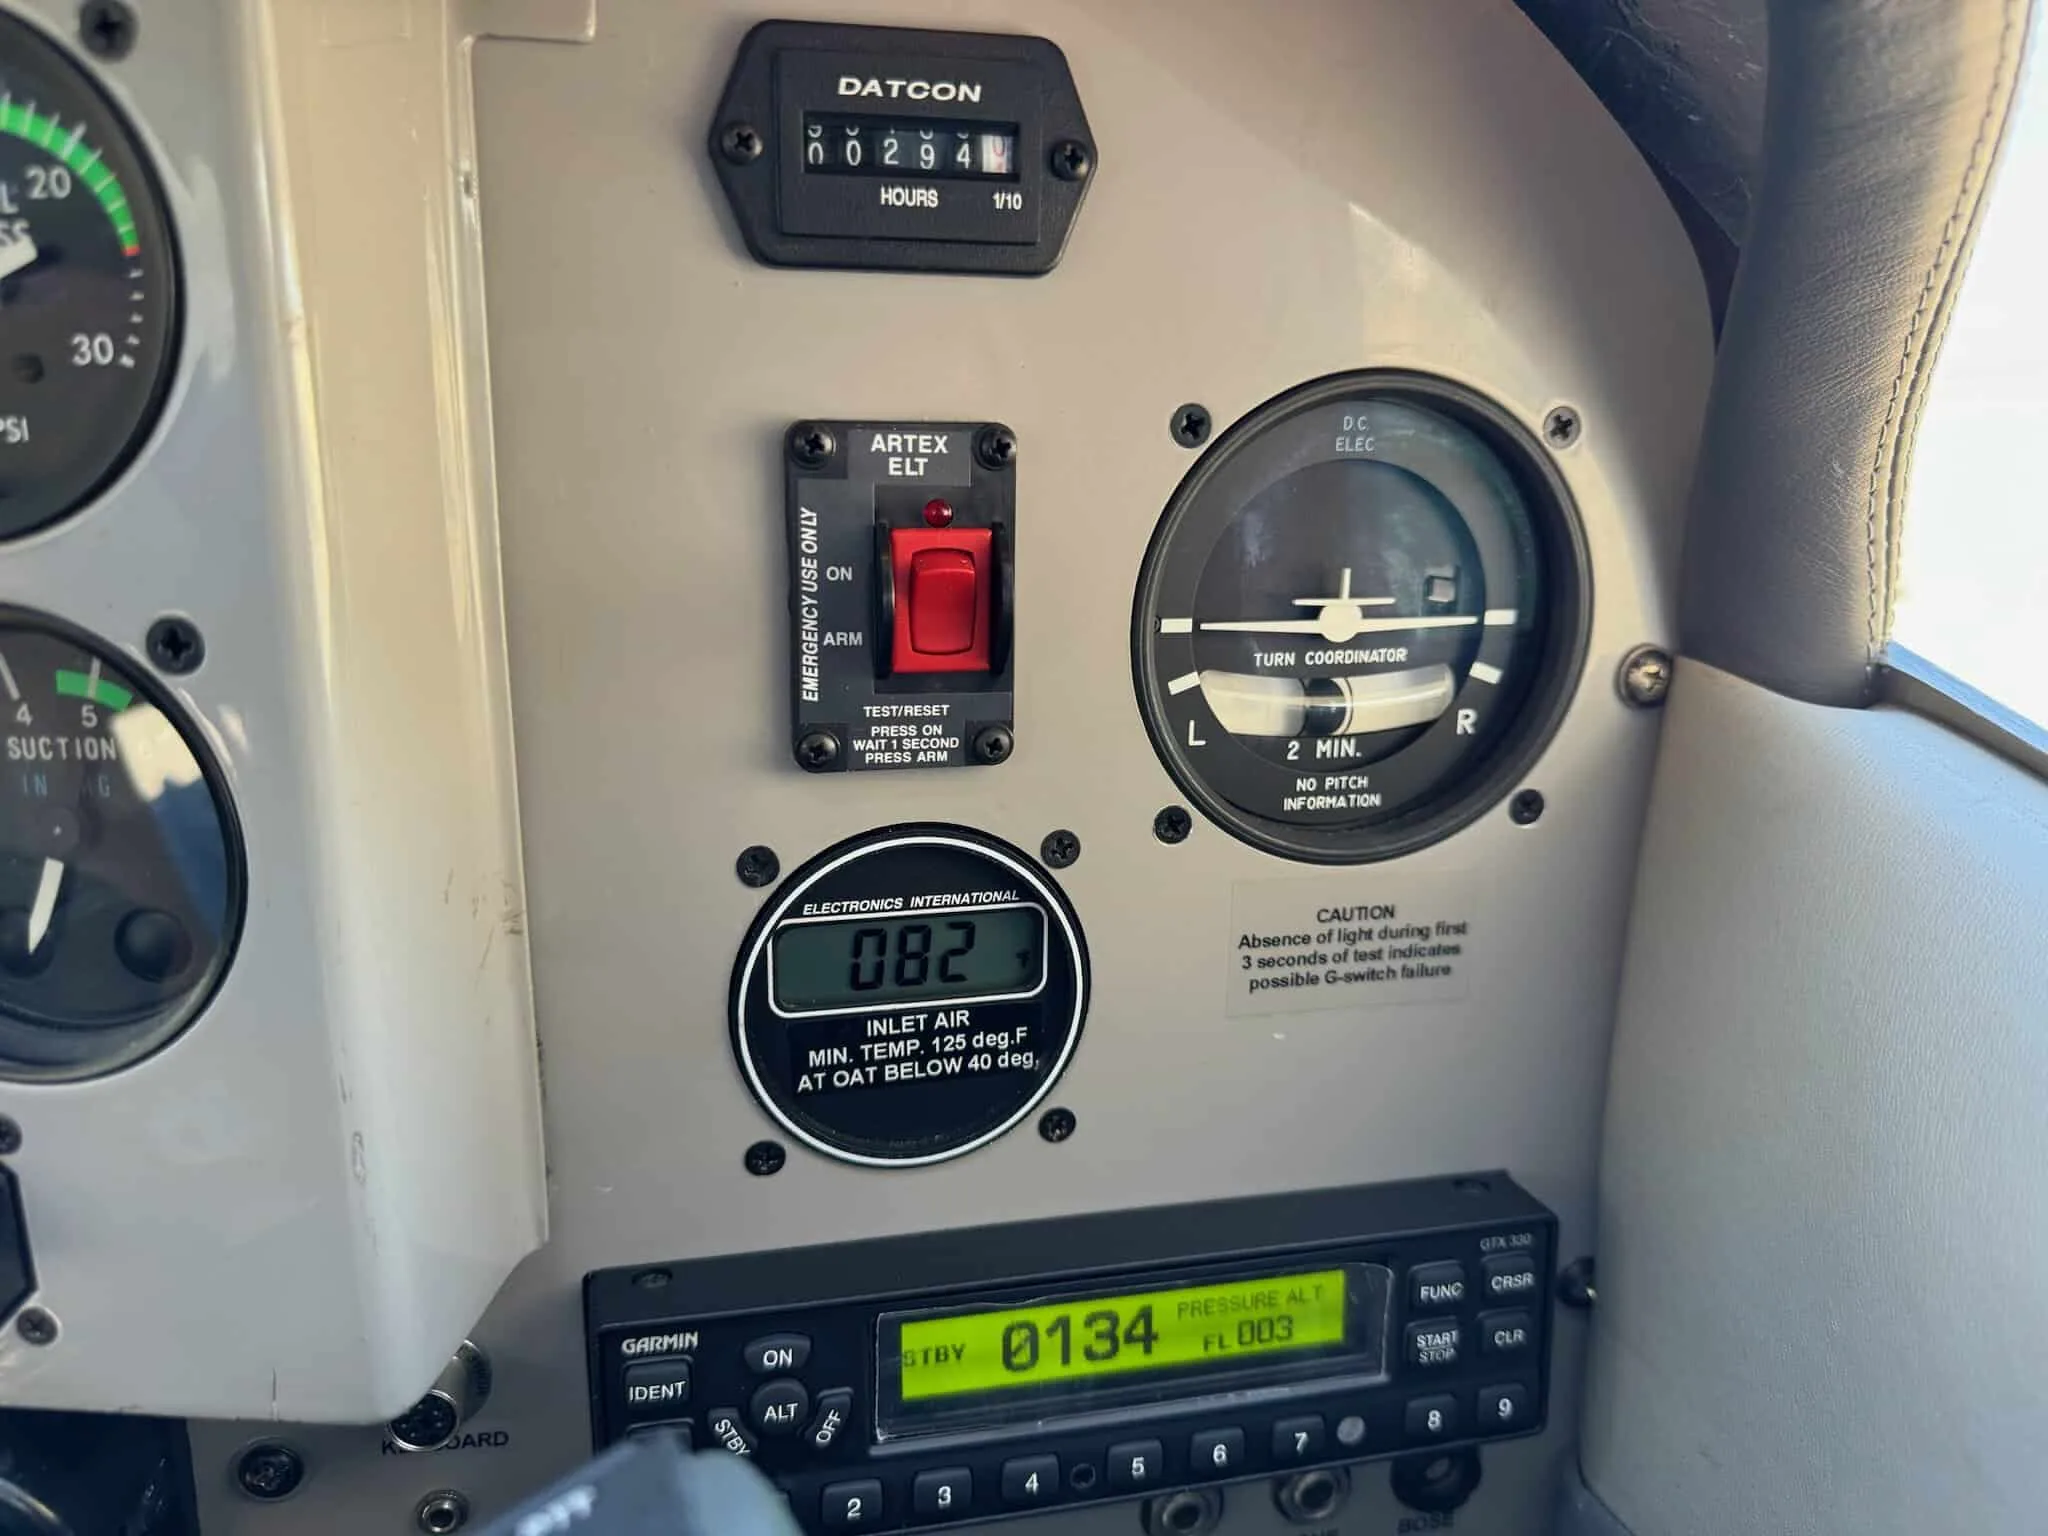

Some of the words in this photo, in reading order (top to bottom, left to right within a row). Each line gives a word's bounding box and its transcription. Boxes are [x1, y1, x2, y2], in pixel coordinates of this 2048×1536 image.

[838, 77, 982, 103] DATCON
[26, 166, 72, 200] 20
[880, 187, 939, 208] HOURS
[993, 193, 1022, 211] 1/10
[71, 334, 114, 366] 30
[871, 434, 948, 454] ARTEX
[1335, 436, 1377, 452] ELEC
[889, 457, 928, 476] ELT
[800, 506, 818, 553] ONLY
[800, 554, 818, 593] USE
[826, 566, 853, 581] ON
[801, 595, 818, 702] EMERGENCY
[823, 632, 863, 647] ARM
[1254, 651, 1296, 667] TURN
[1304, 647, 1408, 666] COORDINATOR
[16, 703, 33, 727] 4
[81, 703, 98, 728] 5
[864, 704, 950, 718] TEST/RESET
[1456, 709, 1476, 735] R
[871, 725, 917, 738] PRESS
[922, 725, 943, 737] ON
[1188, 719, 1206, 746] L
[7, 736, 117, 761] SUCTION
[853, 739, 890, 751] WAIT
[892, 739, 898, 751] 1
[902, 737, 960, 750] SECOND
[1287, 741, 1300, 761] 2
[1316, 737, 1363, 759] MIN.
[865, 751, 916, 765] PRESS
[917, 750, 948, 763] ARM
[1296, 777, 1318, 793] NO
[1325, 775, 1369, 791] PITCH
[1283, 792, 1382, 811] INFORMATION
[802, 897, 903, 916] ELECTRONICS
[909, 889, 1021, 909] INTERNATIONAL
[1316, 904, 1396, 924] CAUTION
[1238, 934, 1311, 950] Absence
[1316, 929, 1334, 945] of
[1337, 926, 1374, 945] light
[1378, 923, 1431, 942] during
[1435, 920, 1468, 936] first
[850, 920, 977, 991] 082
[1241, 955, 1252, 970] 3
[1257, 950, 1328, 969] seconds
[1332, 947, 1349, 964] of
[1353, 946, 1383, 962] test
[1388, 943, 1462, 961] indicates
[1249, 971, 1320, 994] possible
[1324, 965, 1397, 985] G-switch
[1401, 963, 1452, 980] failure
[866, 1014, 929, 1038] INLET
[934, 1009, 971, 1031] AIR
[808, 1046, 854, 1067] MIN.
[860, 1039, 924, 1062] TEMP.
[931, 1033, 967, 1053] 125
[971, 1026, 1029, 1050] deg.F
[797, 1073, 826, 1093] AT
[832, 1066, 878, 1088] OAT
[884, 1056, 963, 1081] BELOW
[967, 1053, 993, 1072] 40
[1420, 1281, 1464, 1303] FUNC
[1491, 1271, 1535, 1291] CRSR
[1177, 1289, 1280, 1321] PRESSURE
[1286, 1283, 1323, 1306] ALT
[621, 1331, 699, 1355] GARMIN
[903, 1343, 966, 1368] STBY
[1002, 1305, 1159, 1373] 0134
[1203, 1333, 1231, 1352] FL
[1237, 1314, 1294, 1347] 003
[1416, 1329, 1458, 1349] START
[1494, 1328, 1526, 1346] CLR
[763, 1348, 793, 1369] ON
[1418, 1348, 1455, 1364] STOP
[628, 1380, 686, 1403] IDENT
[764, 1402, 799, 1423] ALT
[1498, 1397, 1513, 1419] 9
[815, 1408, 842, 1446] OFF
[1427, 1408, 1442, 1431] 8
[714, 1417, 751, 1457] STBY
[1293, 1431, 1308, 1452] 7
[1212, 1443, 1227, 1465] 6
[1131, 1456, 1146, 1477] 5
[1024, 1470, 1040, 1495] 4
[937, 1485, 952, 1506] 3
[846, 1497, 862, 1519] 2
